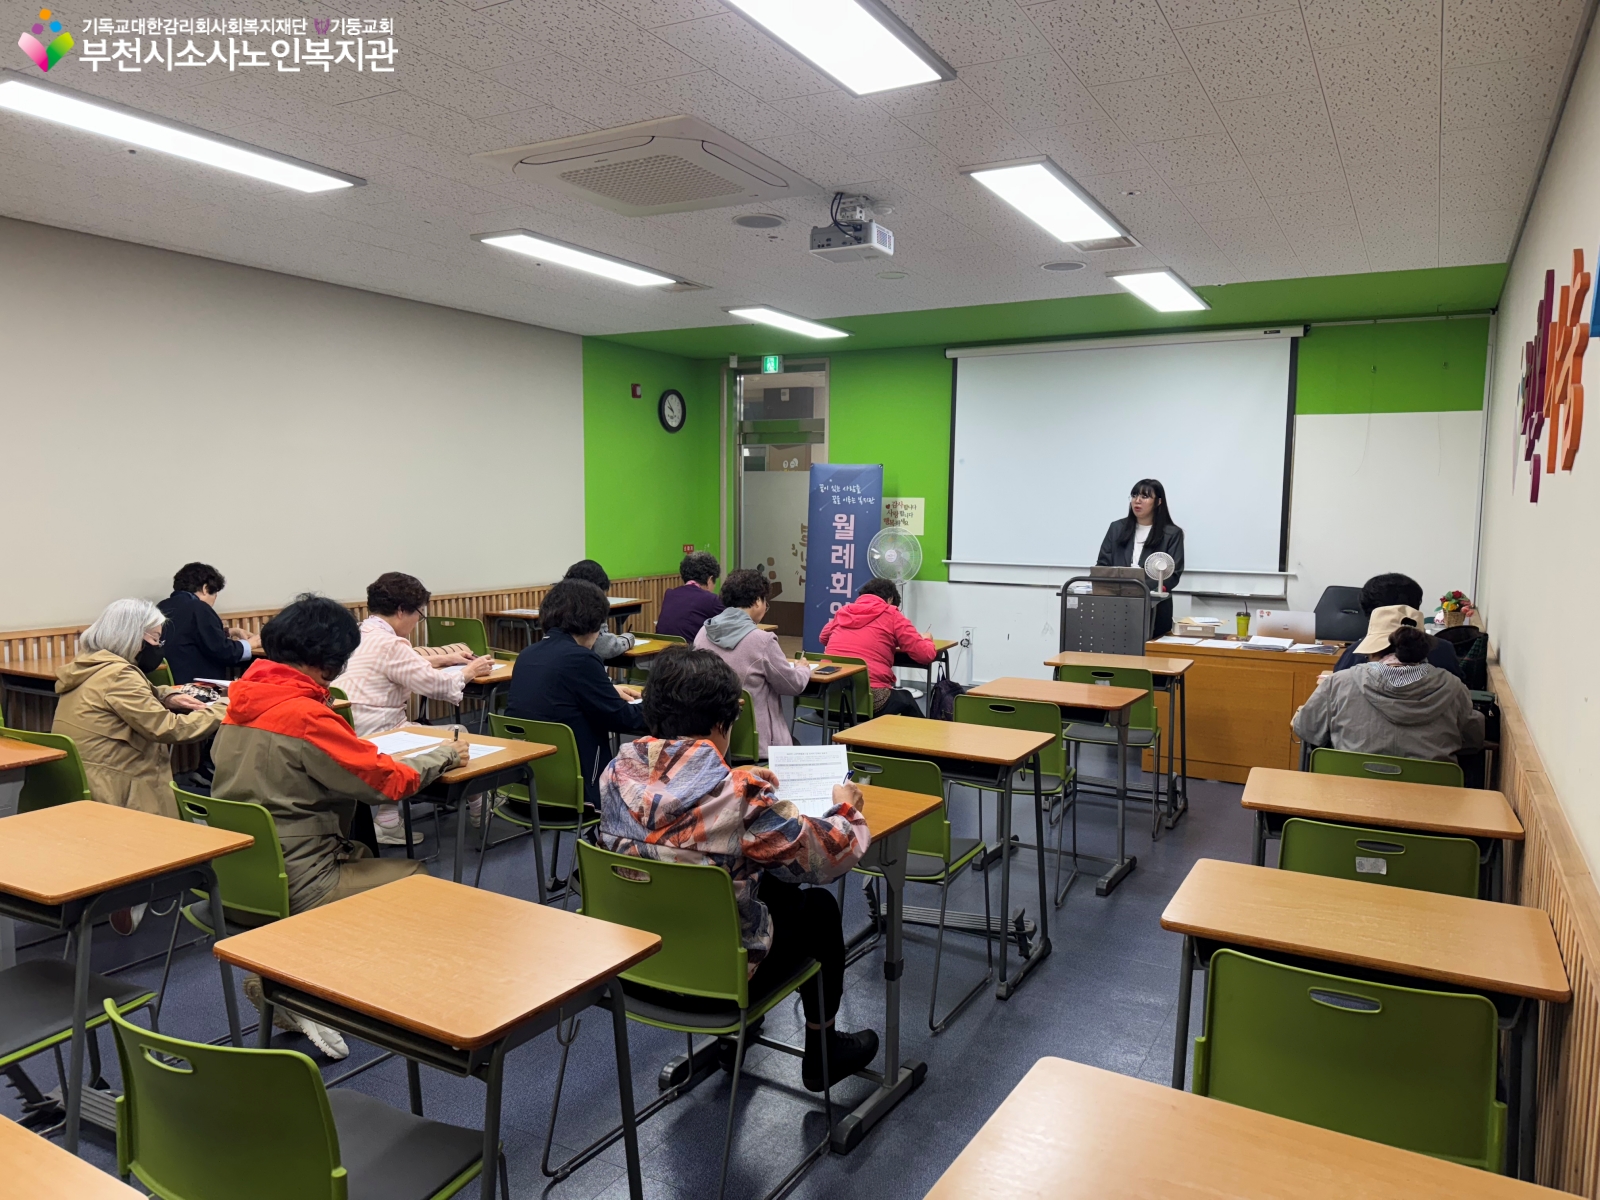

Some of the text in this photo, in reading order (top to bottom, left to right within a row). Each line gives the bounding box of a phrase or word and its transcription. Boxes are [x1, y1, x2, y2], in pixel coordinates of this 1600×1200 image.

[842, 495, 856, 505] 이루는
[857, 495, 876, 505] 복지관
[892, 501, 917, 511] 감사합니다
[886, 509, 914, 519] 사랑합니다
